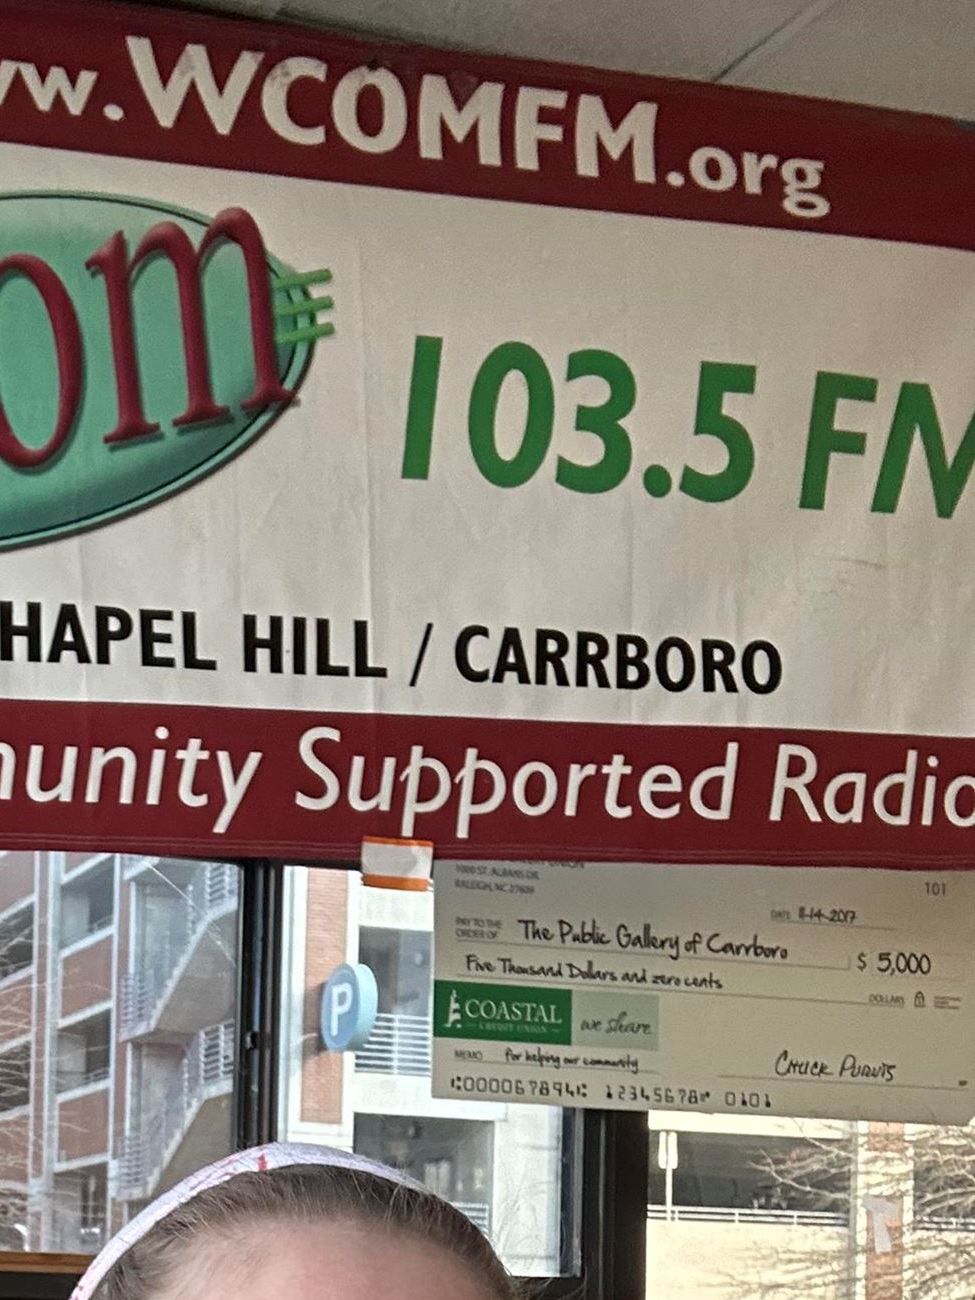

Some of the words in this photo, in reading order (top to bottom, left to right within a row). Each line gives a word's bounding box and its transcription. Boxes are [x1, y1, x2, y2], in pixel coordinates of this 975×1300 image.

[401, 335, 757, 503] 103.5
[798, 370, 975, 519] FM
[243, 614, 387, 678] HILL
[454, 625, 782, 695] CARRBORO
[295, 726, 740, 838] Supported
[768, 741, 975, 829] Radio
[925, 882, 946, 896] 101
[518, 919, 555, 941] The
[558, 919, 611, 944] Public
[616, 923, 680, 960] Gallery
[684, 932, 701, 954] of
[706, 932, 788, 960] Carrboro
[466, 954, 494, 973] Five
[497, 958, 563, 977] Thousand
[568, 961, 617, 982] Dollars
[621, 966, 647, 984] and
[651, 973, 681, 988] zero
[684, 972, 723, 990] cents
[877, 952, 932, 976] 5,000
[330, 982, 354, 1037] P
[465, 999, 563, 1024] COASTAL
[580, 1018, 602, 1033] we
[605, 1010, 653, 1035] share
[454, 1049, 483, 1060] MEMO
[525, 1046, 561, 1069] helping
[563, 1056, 578, 1065] our
